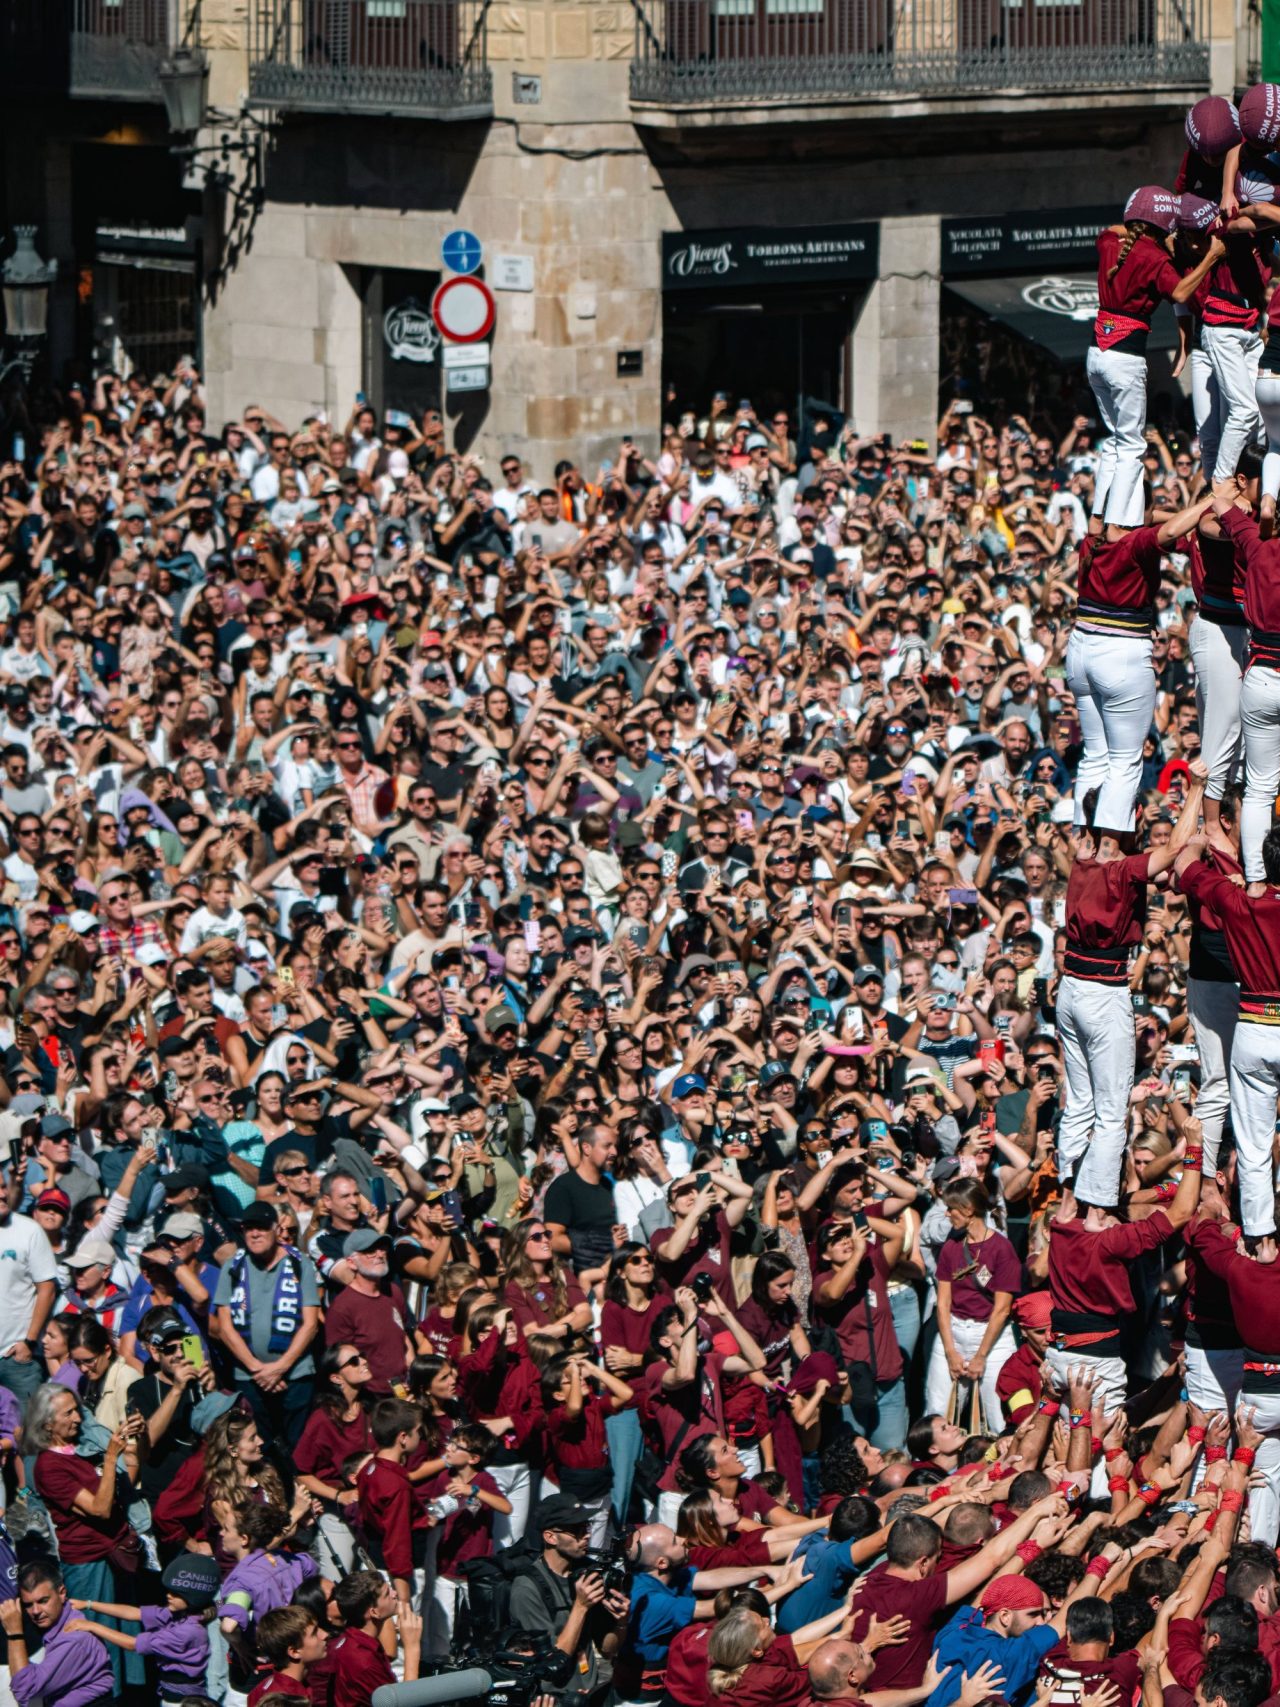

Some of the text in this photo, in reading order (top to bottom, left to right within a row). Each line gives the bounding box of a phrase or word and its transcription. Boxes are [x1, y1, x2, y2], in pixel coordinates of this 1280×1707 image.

[1153, 194, 1172, 203] SOM
[1154, 204, 1173, 213] SOM
[1192, 204, 1213, 220] SOM
[1197, 212, 1217, 229] SOM
[746, 240, 866, 257] TORRONS ARTESANS
[670, 243, 739, 276] Vicens
